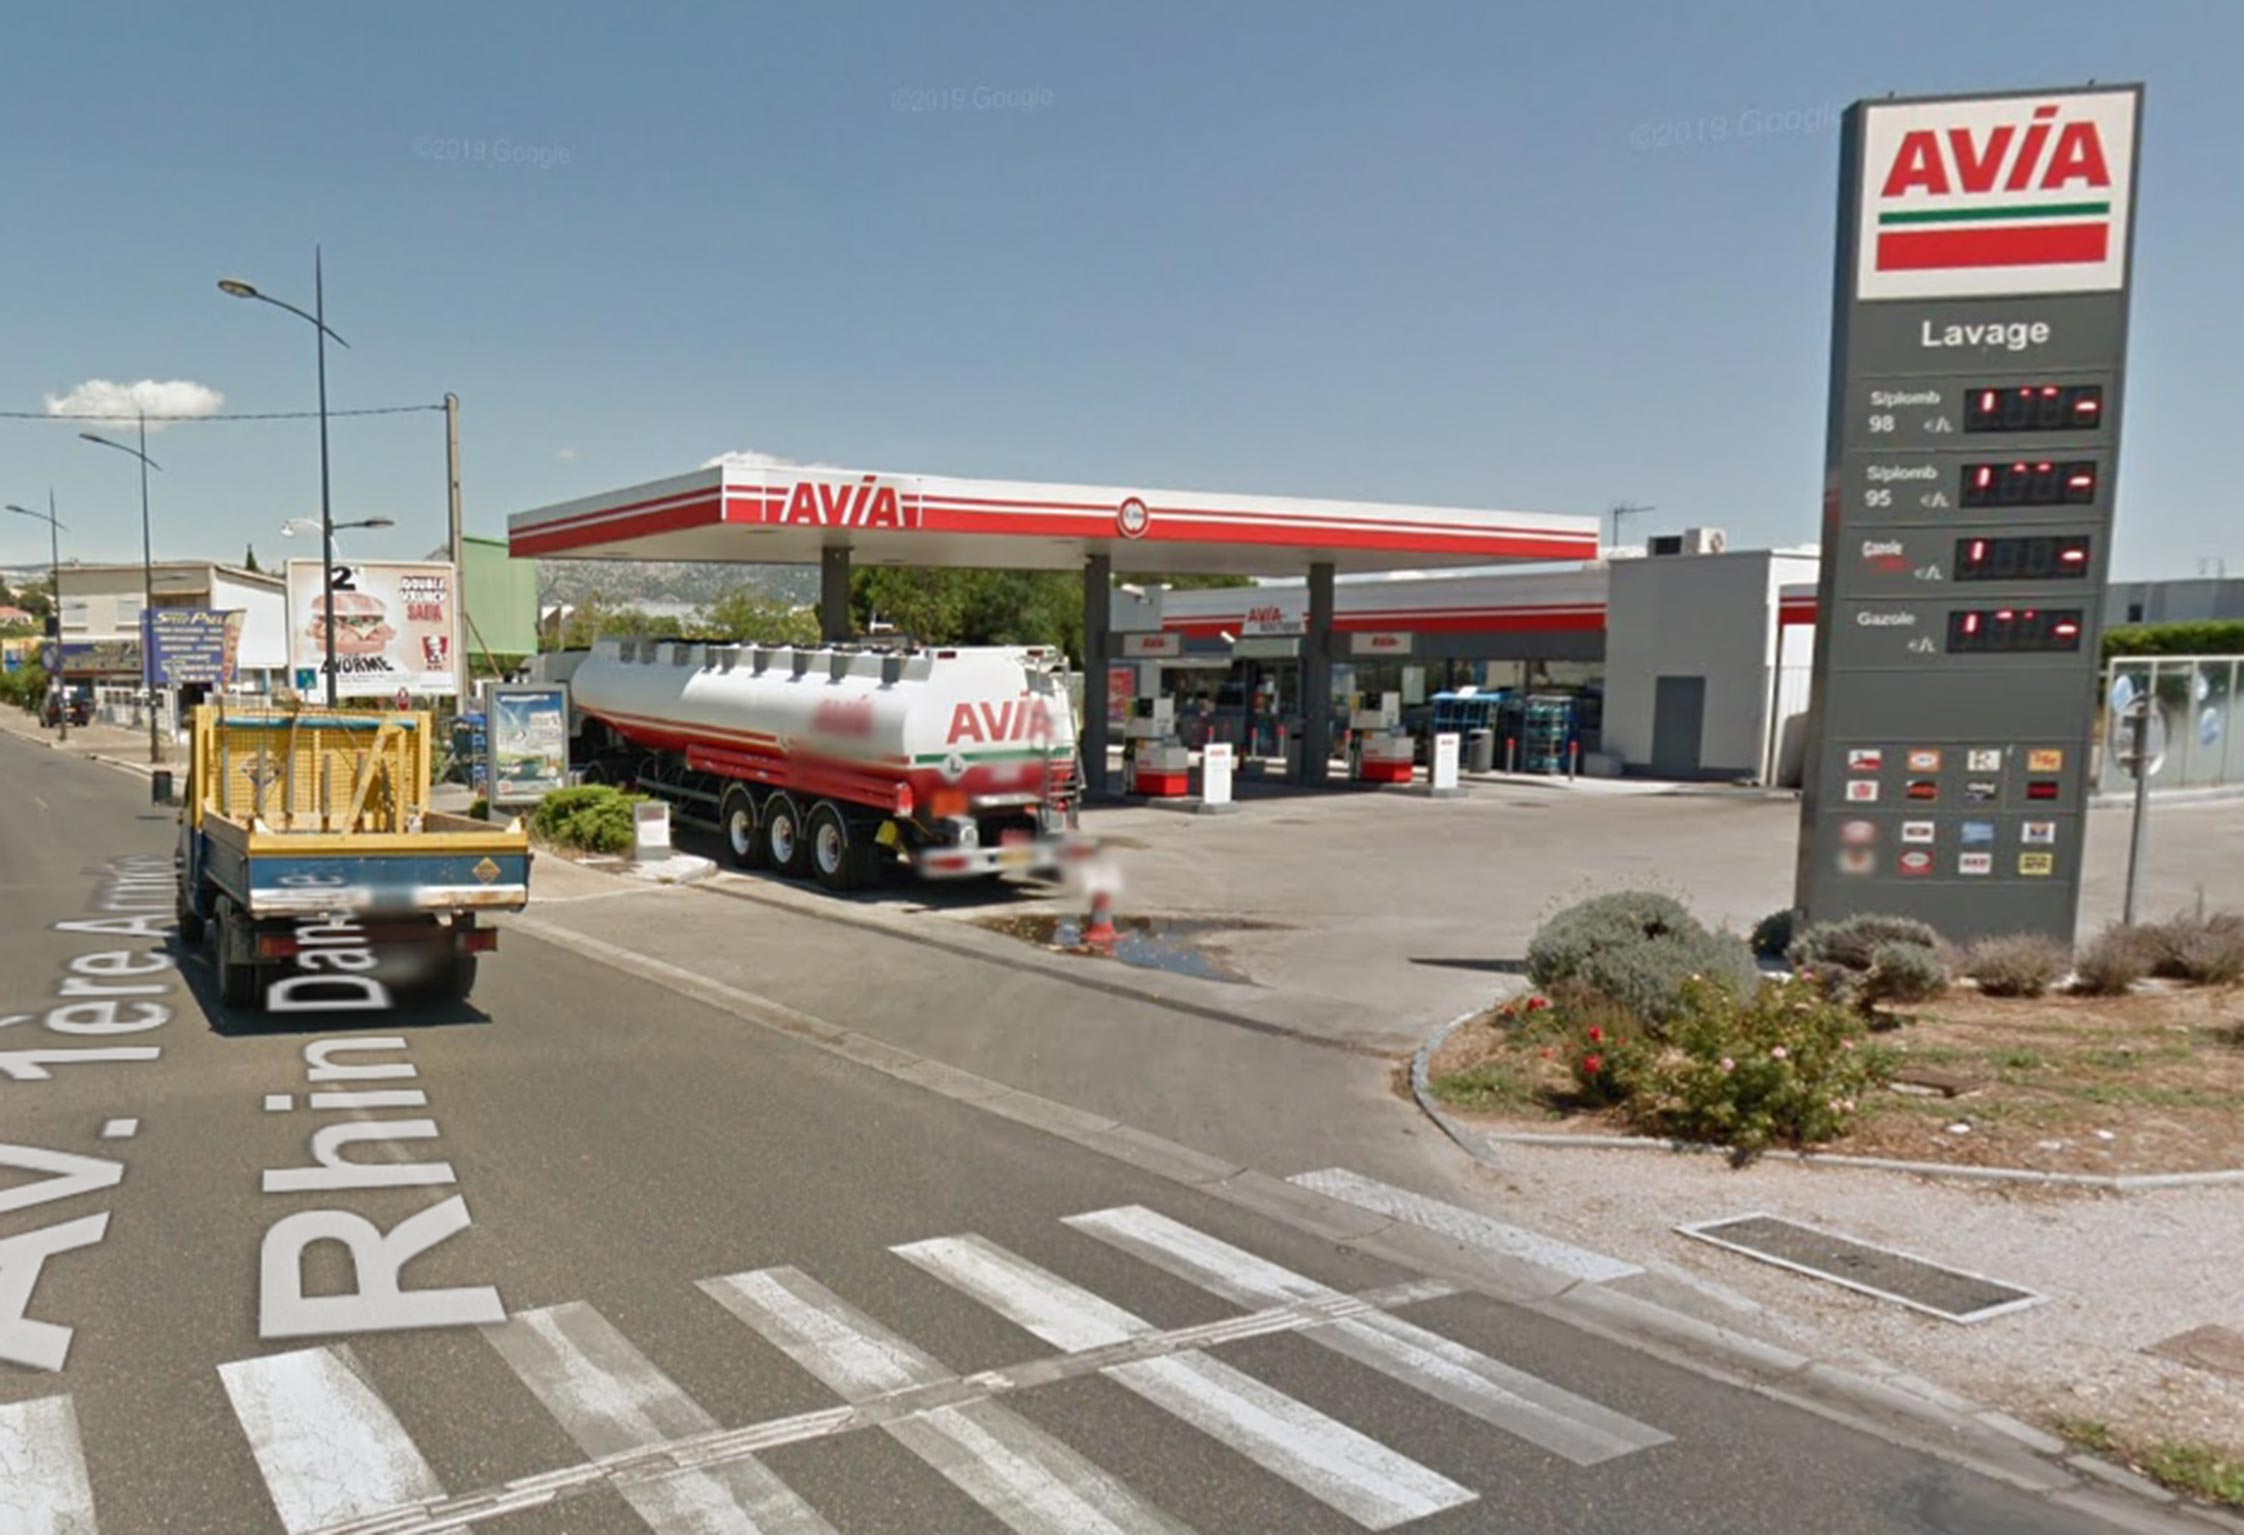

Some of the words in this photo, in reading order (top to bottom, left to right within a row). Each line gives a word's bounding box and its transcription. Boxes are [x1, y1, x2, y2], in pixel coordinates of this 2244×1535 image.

[1881, 105, 2111, 197] AVIA
[1921, 319, 2050, 350] Lavage
[1868, 415, 1895, 432] 98
[785, 474, 900, 528] AVIA
[1865, 489, 1892, 507] 95
[1857, 611, 1916, 626] Gazole
[946, 689, 1056, 744] AVIA
